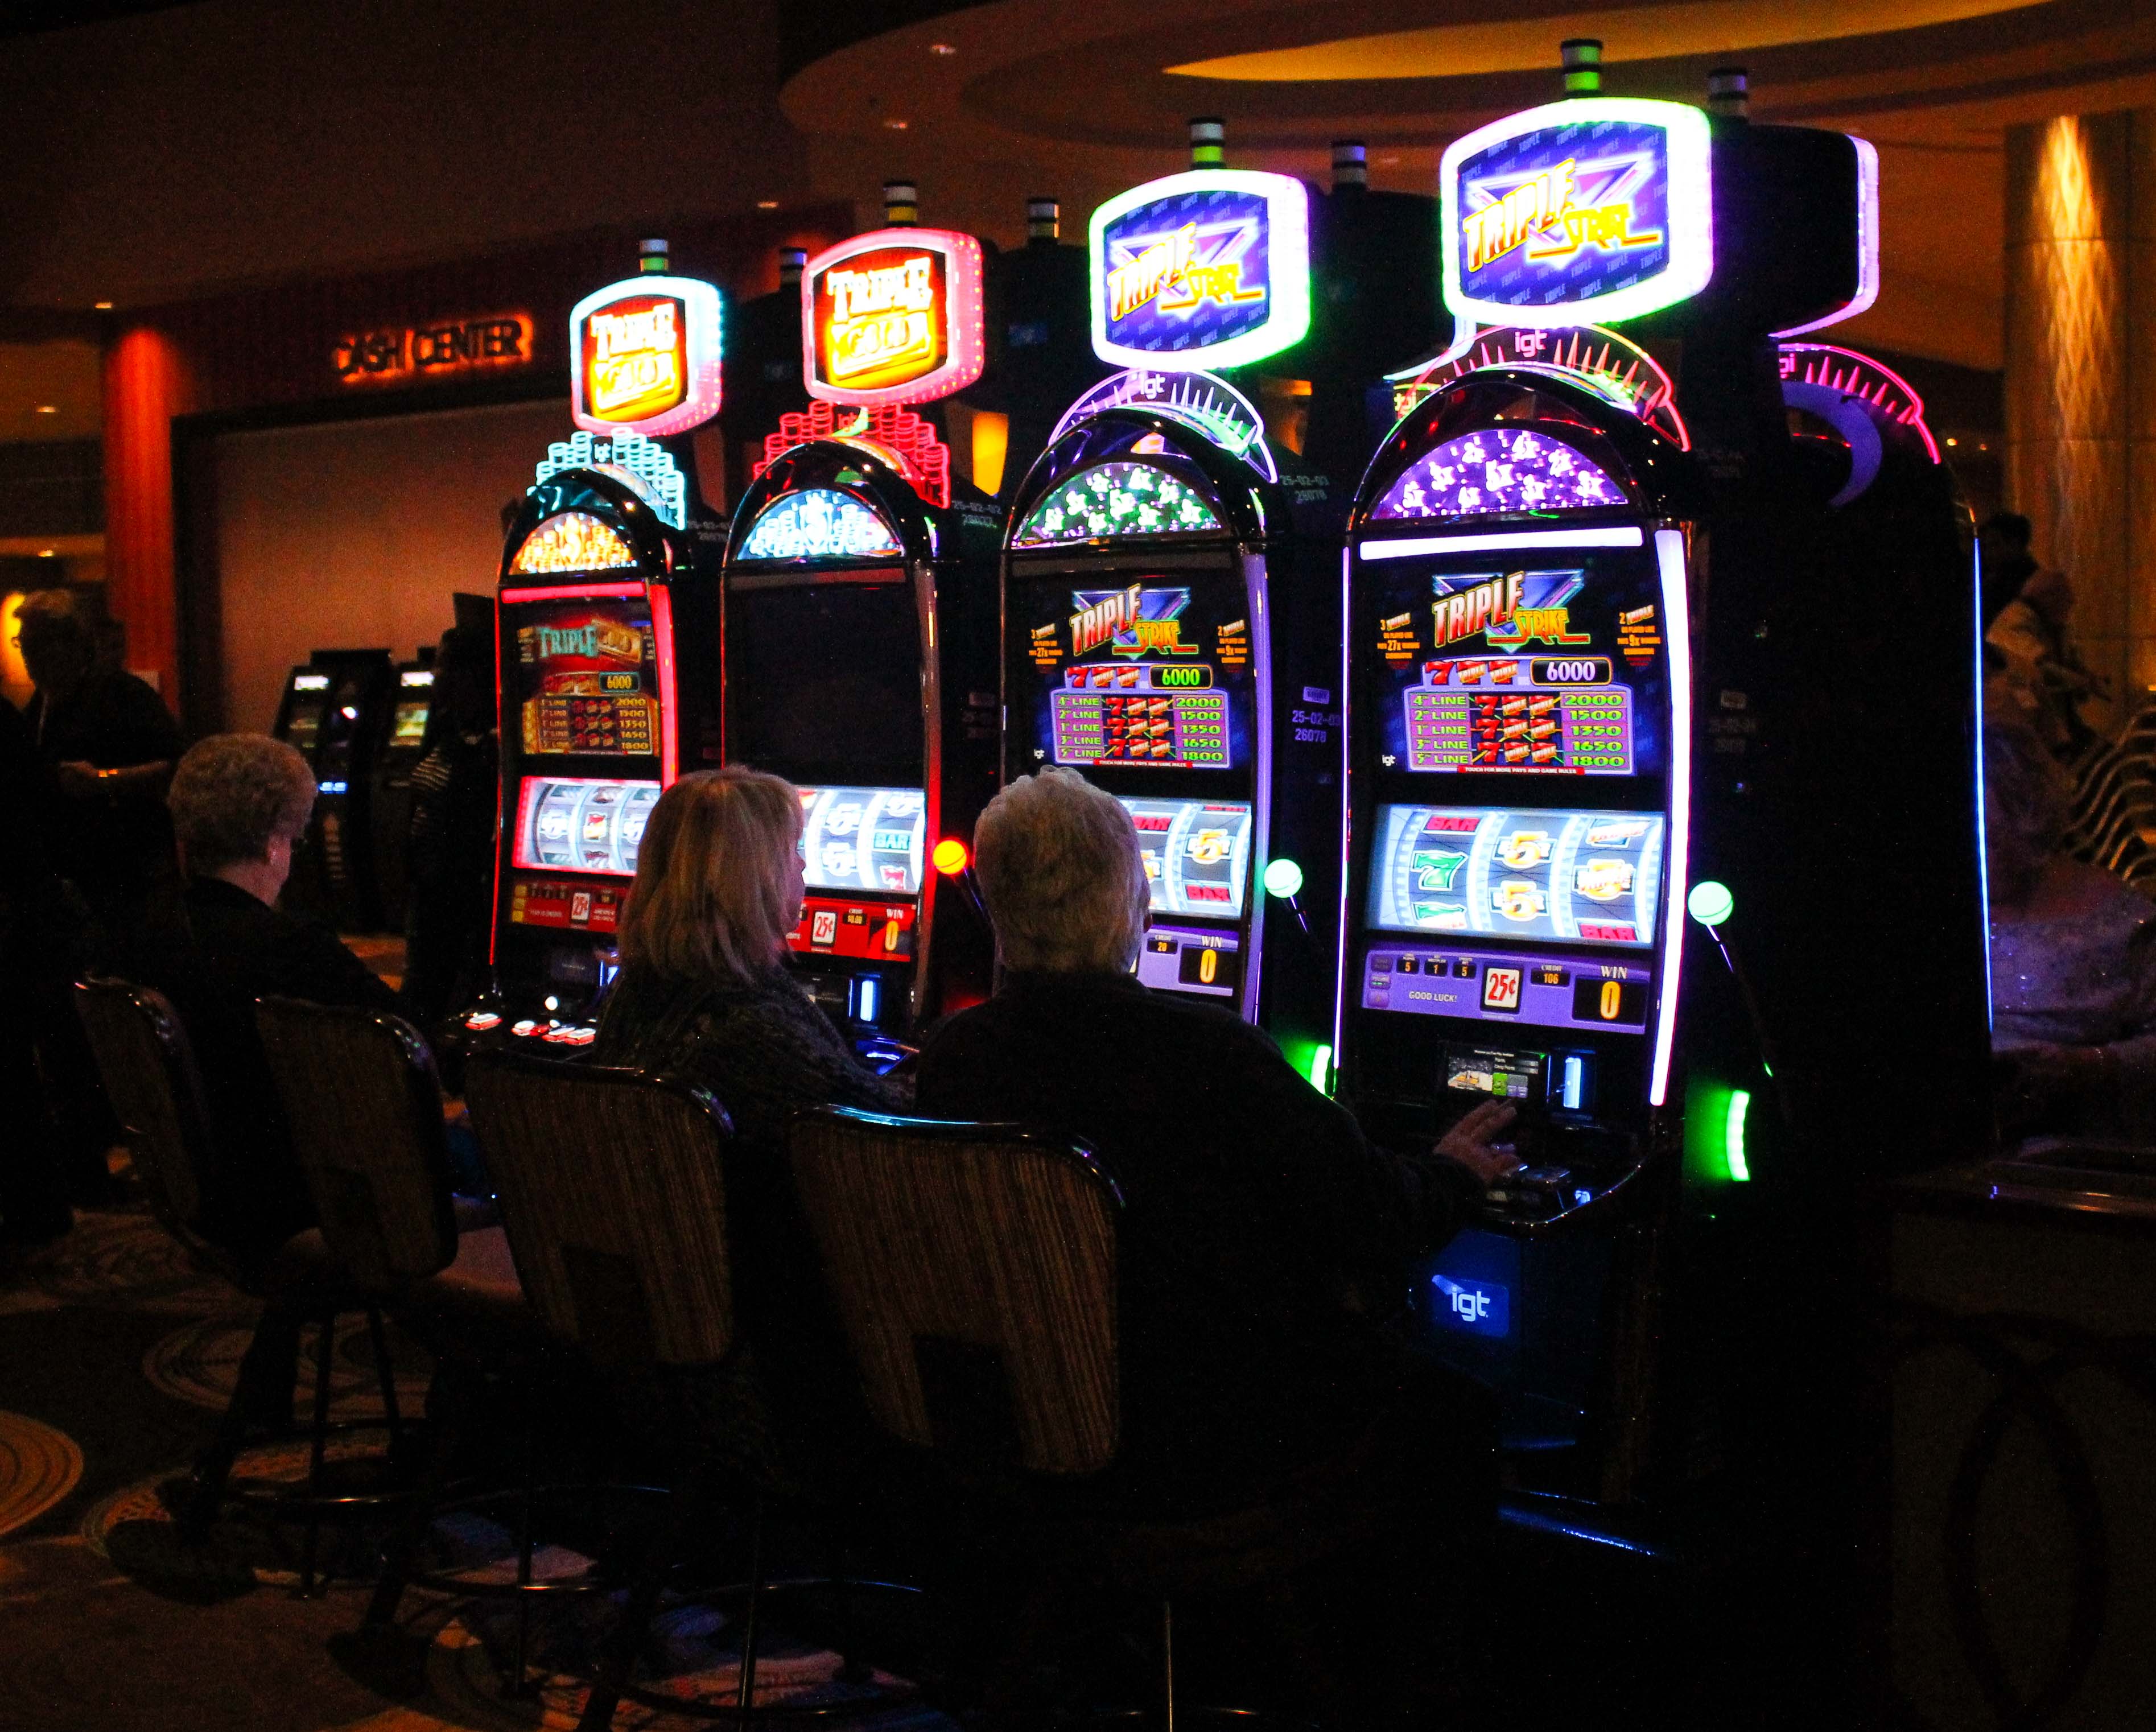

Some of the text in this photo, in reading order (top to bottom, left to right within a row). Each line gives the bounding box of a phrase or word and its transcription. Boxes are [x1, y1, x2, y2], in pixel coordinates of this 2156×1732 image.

[1462, 158, 1575, 273] TRIPLE
[1107, 222, 1196, 321] TRIPLE
[827, 257, 933, 324] TRIPLE
[591, 303, 677, 361] TRIPLE
[333, 319, 525, 375] CASH CENTER
[1514, 329, 1548, 358] igt
[1432, 571, 1526, 648] TRIPLE
[1069, 583, 1141, 656] TRIPLE
[1619, 612, 1626, 624] 2
[1487, 607, 1592, 646] STRIKE
[539, 625, 598, 658] TRIPLE
[1112, 620, 1199, 654] STRIKE
[1162, 669, 1201, 686] 6000
[1547, 661, 1596, 681] 6000
[607, 675, 633, 690] 6000
[1176, 698, 1221, 707] 2000
[1432, 696, 1466, 705] LINE
[1565, 695, 1623, 706] 2000
[1180, 711, 1221, 720] 1500
[1432, 711, 1466, 720] LINE
[1570, 710, 1623, 721] 1500
[1432, 726, 1467, 735] LINE
[1570, 725, 1622, 736] 1350
[1182, 739, 1222, 748] 1650
[1572, 741, 1623, 752] 1650
[1182, 752, 1223, 761] 1800
[1382, 755, 1396, 766] igt
[1570, 756, 1626, 766] 1800
[1426, 816, 1480, 832] BAR
[875, 832, 909, 850] BAR
[886, 909, 904, 919] WIN
[815, 916, 834, 938] 25¢
[1580, 923, 1636, 941] BAR
[885, 921, 898, 951] 0
[1201, 936, 1223, 948] WIN
[1200, 949, 1217, 983] 0
[1405, 962, 1411, 972] 5
[1462, 966, 1467, 977] 5
[1601, 966, 1627, 979] WIN
[1487, 973, 1516, 1001] 25¢
[1409, 991, 1457, 1003] GOOD LUCK!
[1600, 981, 1620, 1020] 0
[1452, 1286, 1490, 1322] igt
